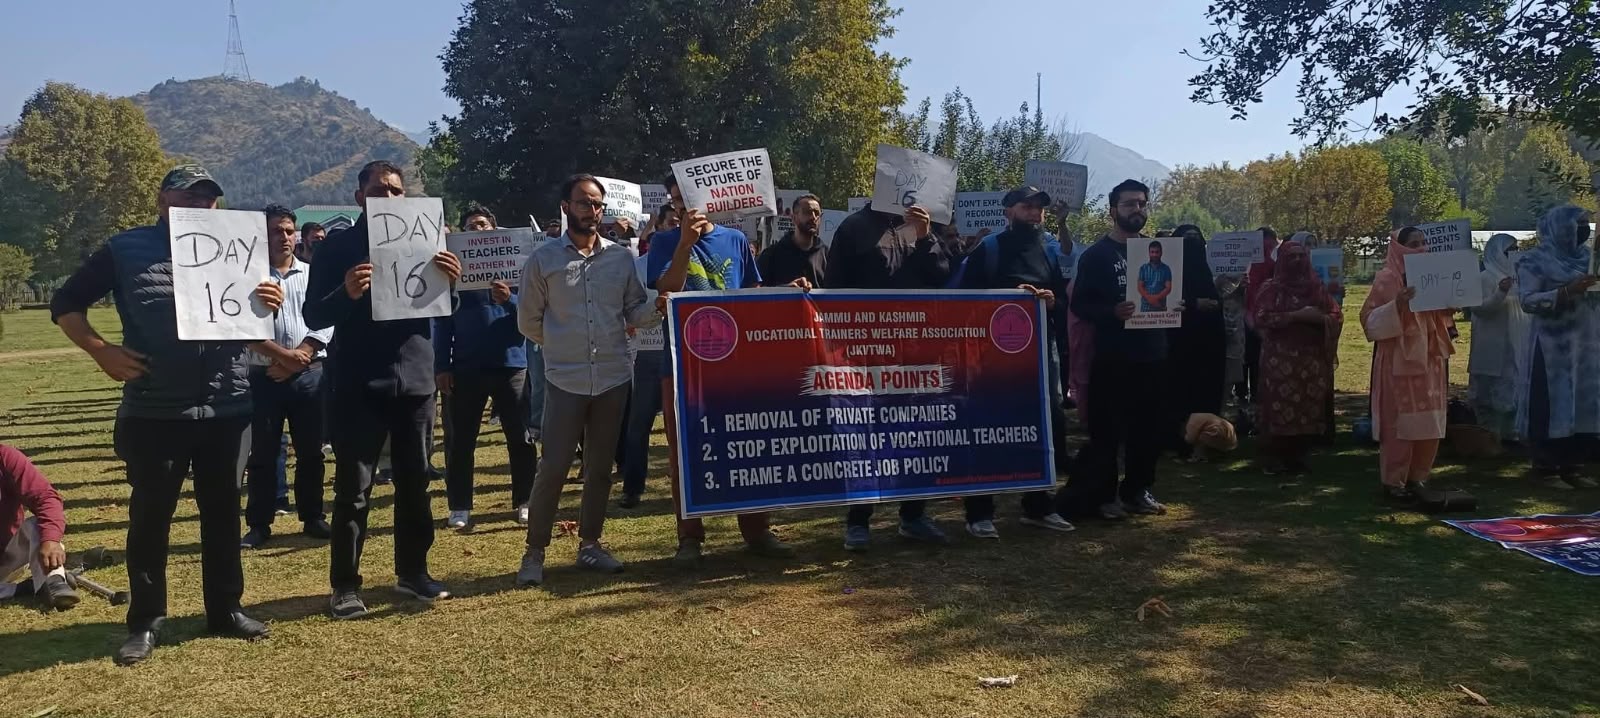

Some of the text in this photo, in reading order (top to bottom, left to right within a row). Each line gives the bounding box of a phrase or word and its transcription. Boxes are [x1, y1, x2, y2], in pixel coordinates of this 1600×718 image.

[685, 155, 763, 177] SECURE THE
[694, 168, 761, 189] FUTURE OF
[894, 169, 927, 191] DAY
[609, 183, 625, 191] STOP
[710, 183, 754, 199] NATION
[605, 191, 640, 205] VATIZATION
[706, 196, 764, 213] BUILDERS
[891, 188, 917, 209] 16
[958, 200, 980, 208] DON'T
[371, 212, 443, 246] DAY
[974, 219, 1006, 227] REWARD
[1422, 224, 1458, 236] VEST IN
[468, 235, 511, 247] INVEST IN
[1424, 233, 1460, 246] UDENTS
[175, 232, 258, 275] DAY
[461, 246, 520, 259] TEACHERS
[469, 260, 516, 271] RATHER IN
[390, 261, 428, 299] 16
[205, 281, 242, 324] 16
[814, 311, 927, 324] JAMMU AND KASHMIR
[746, 327, 986, 342] VOCATIONAL TRAINERS WELFARE ASSOCIATION
[846, 344, 896, 358] (JKVTWA)
[813, 370, 940, 391] AGENDA POINTS
[700, 404, 956, 434] 1. REMOVAL OF PRIVATE COMPANIES
[702, 425, 1038, 461] 2. STOP EXPLOITATION OF VOCATIONAL TEACHERS
[705, 455, 949, 490] 3. FRAME A CONCRETE JOB POLICY
